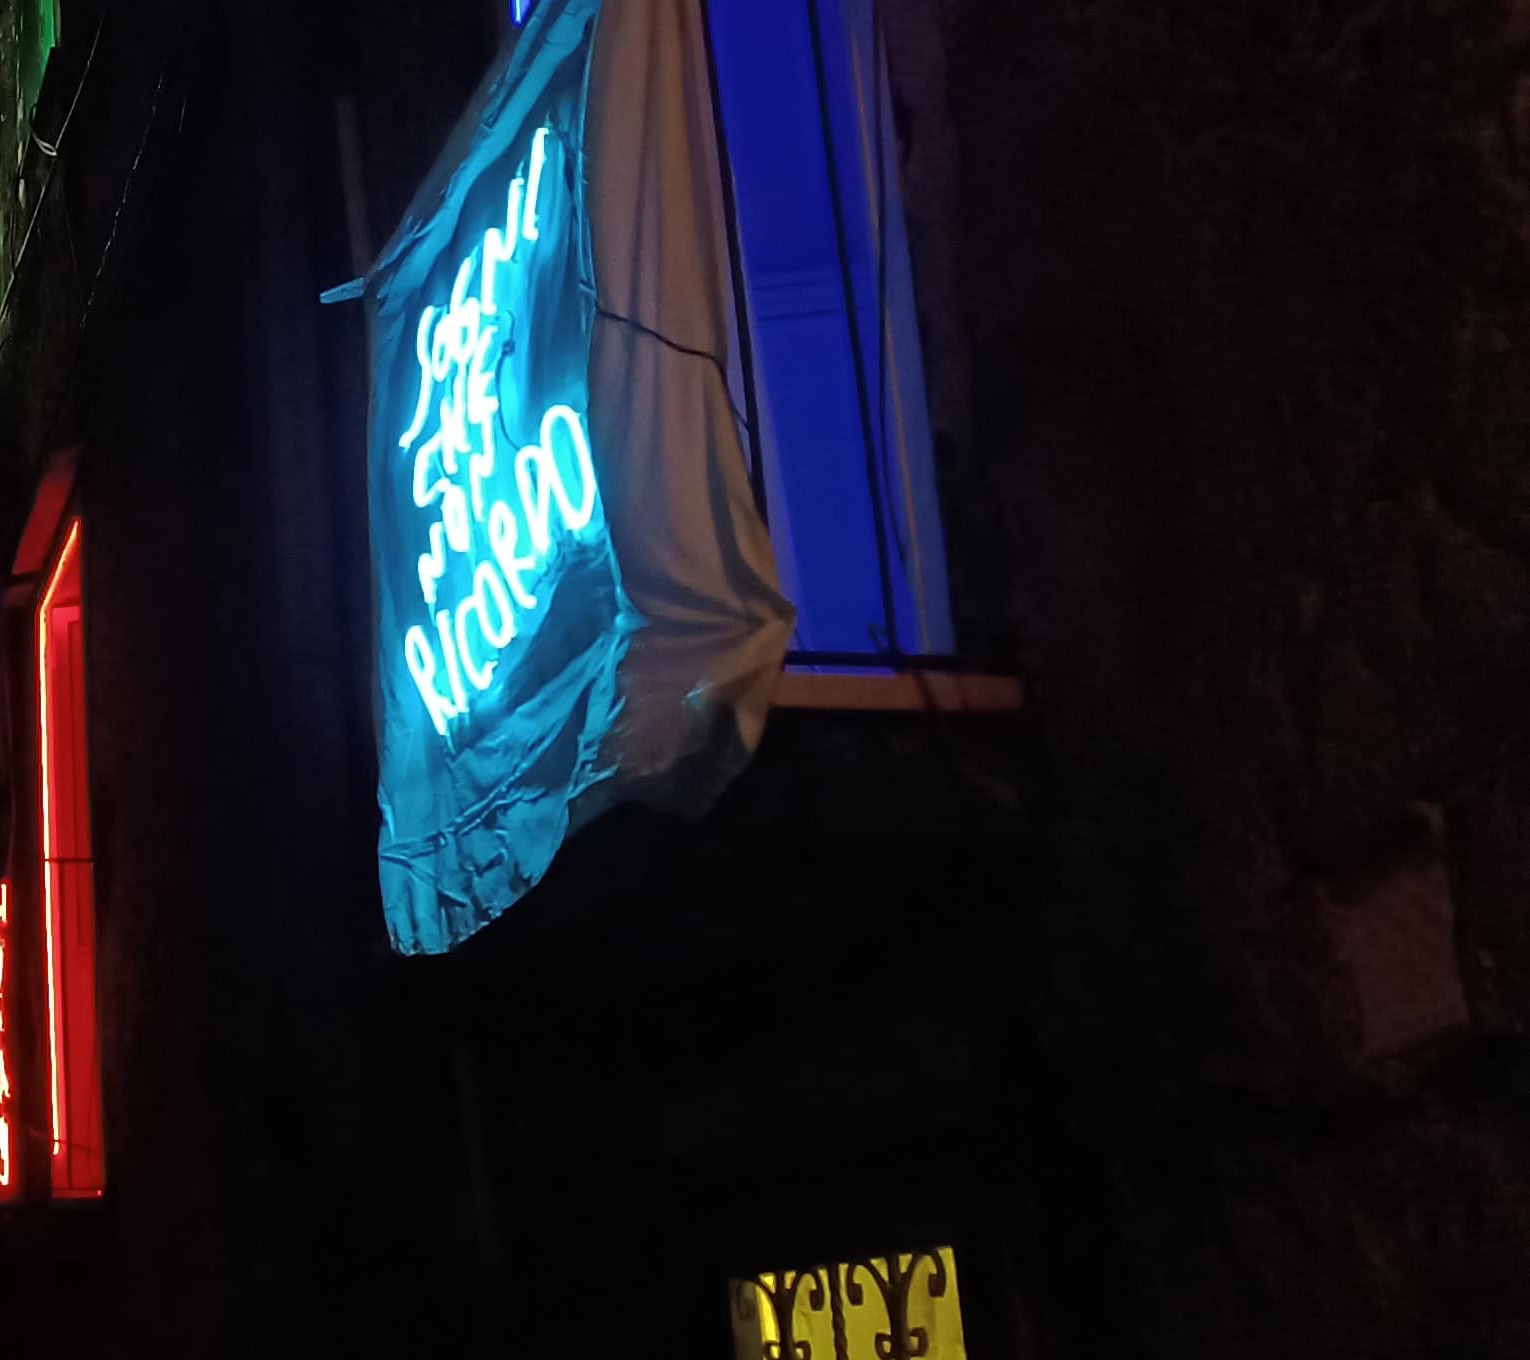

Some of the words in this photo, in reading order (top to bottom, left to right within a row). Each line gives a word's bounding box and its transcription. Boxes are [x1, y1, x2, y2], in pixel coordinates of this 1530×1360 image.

[399, 126, 550, 450] SOGNI
[412, 326, 499, 509] CHE
[418, 420, 494, 604] NON
[404, 403, 598, 736] RICORDO
